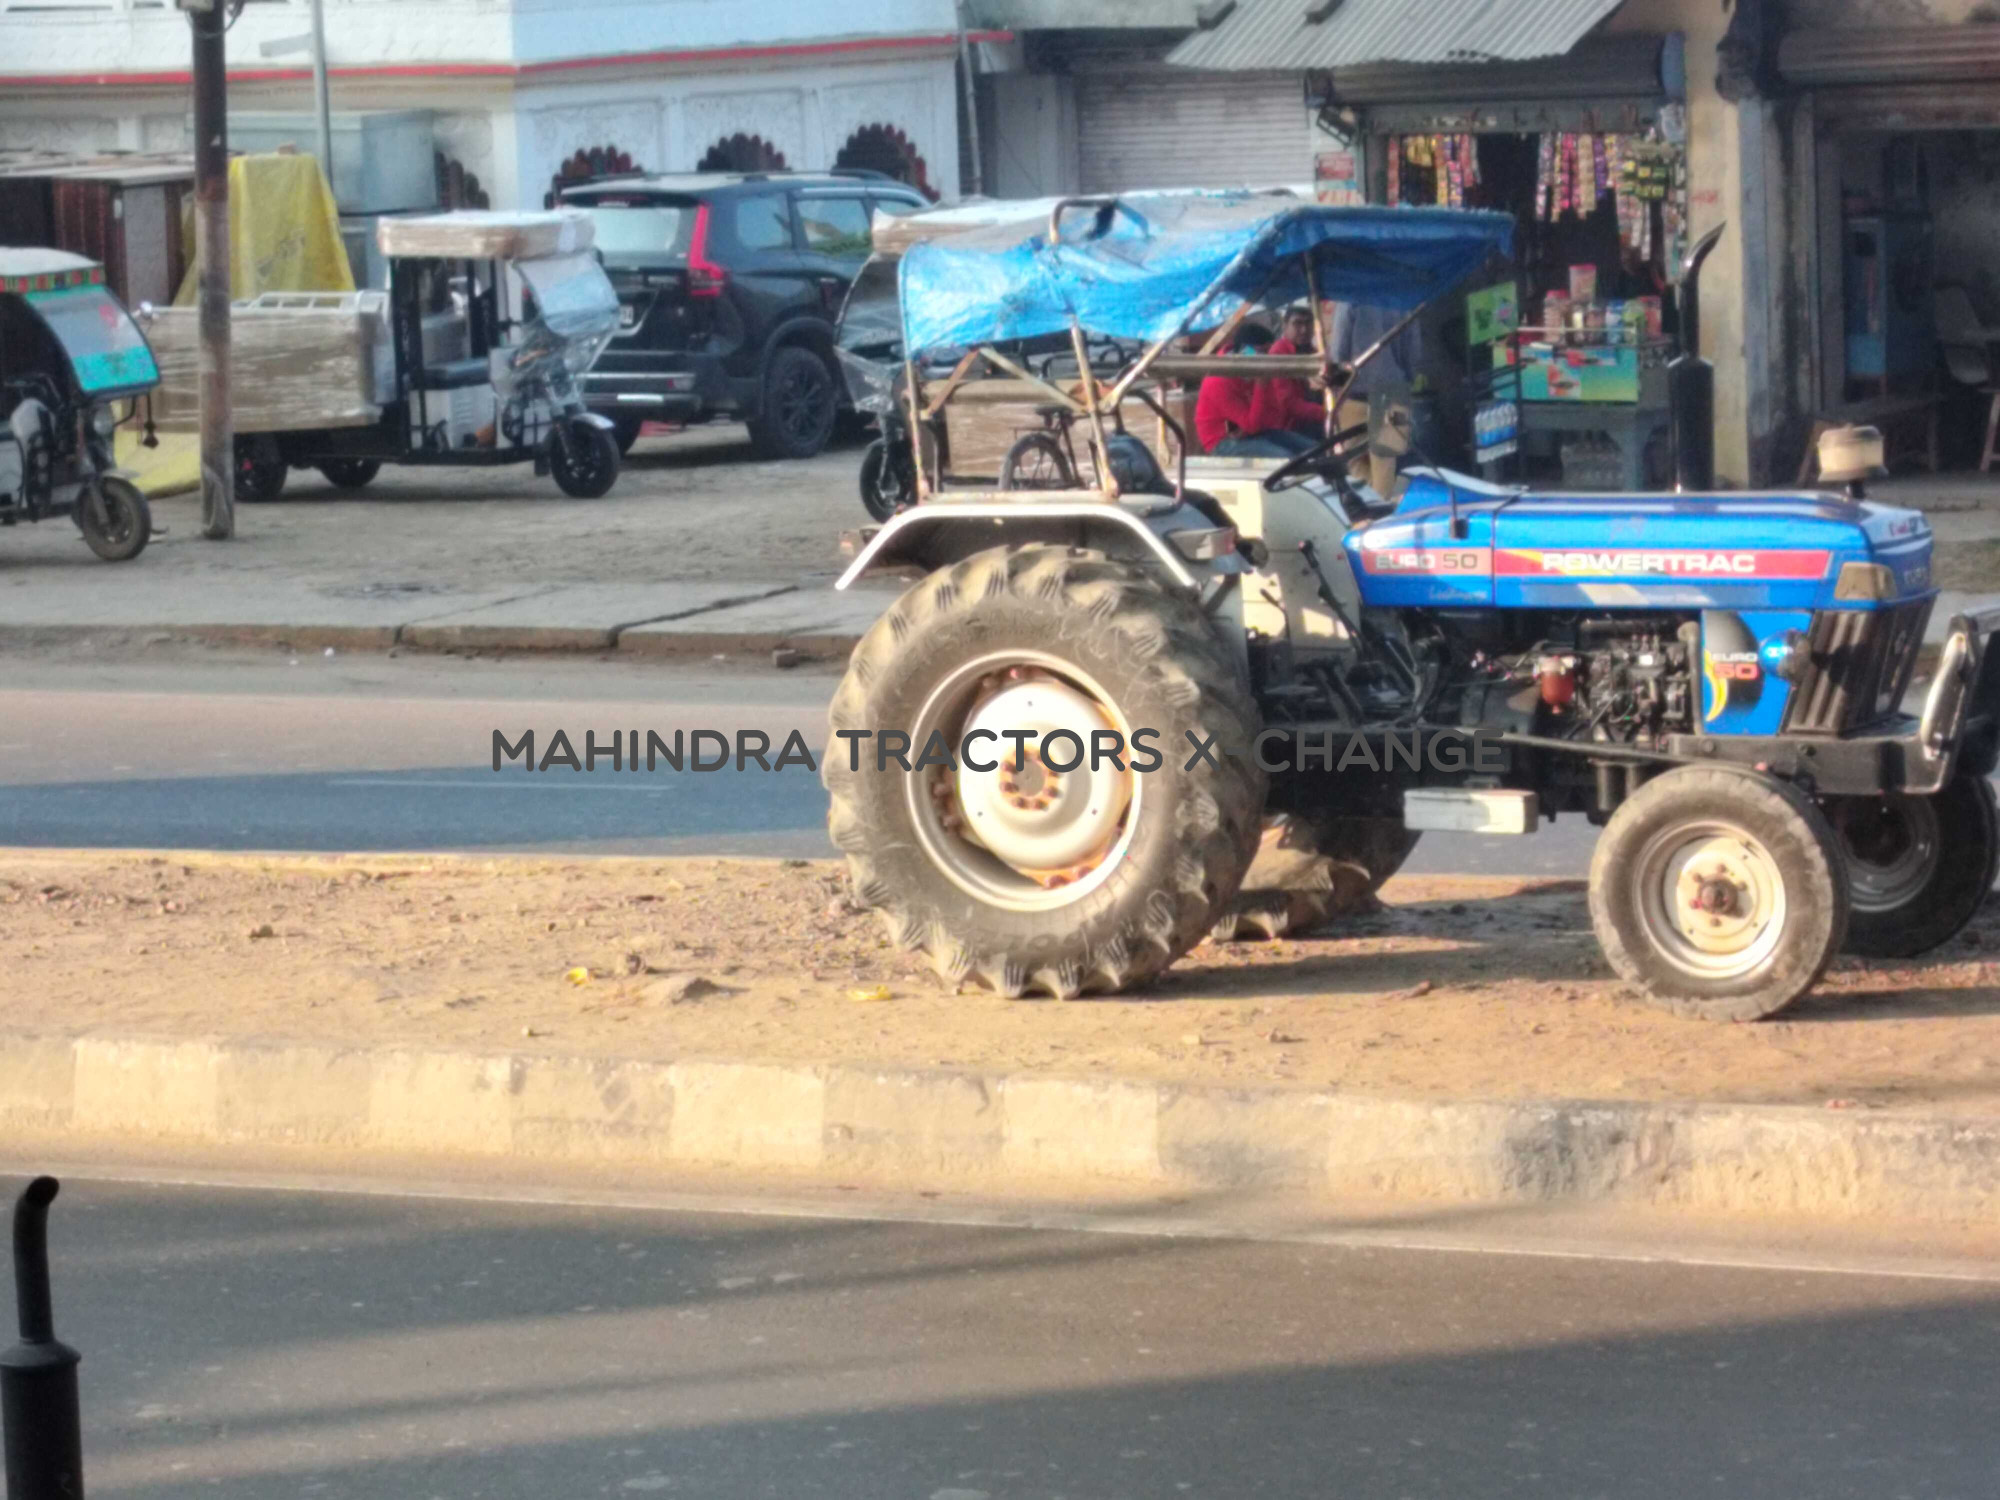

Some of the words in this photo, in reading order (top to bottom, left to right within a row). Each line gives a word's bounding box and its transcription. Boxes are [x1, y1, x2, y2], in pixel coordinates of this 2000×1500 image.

[1375, 553, 1436, 570] EURO
[1443, 553, 1478, 570] 50
[1541, 552, 1756, 573] POWERTRAC
[1711, 652, 1758, 663] EURO
[1713, 662, 1759, 680] 50
